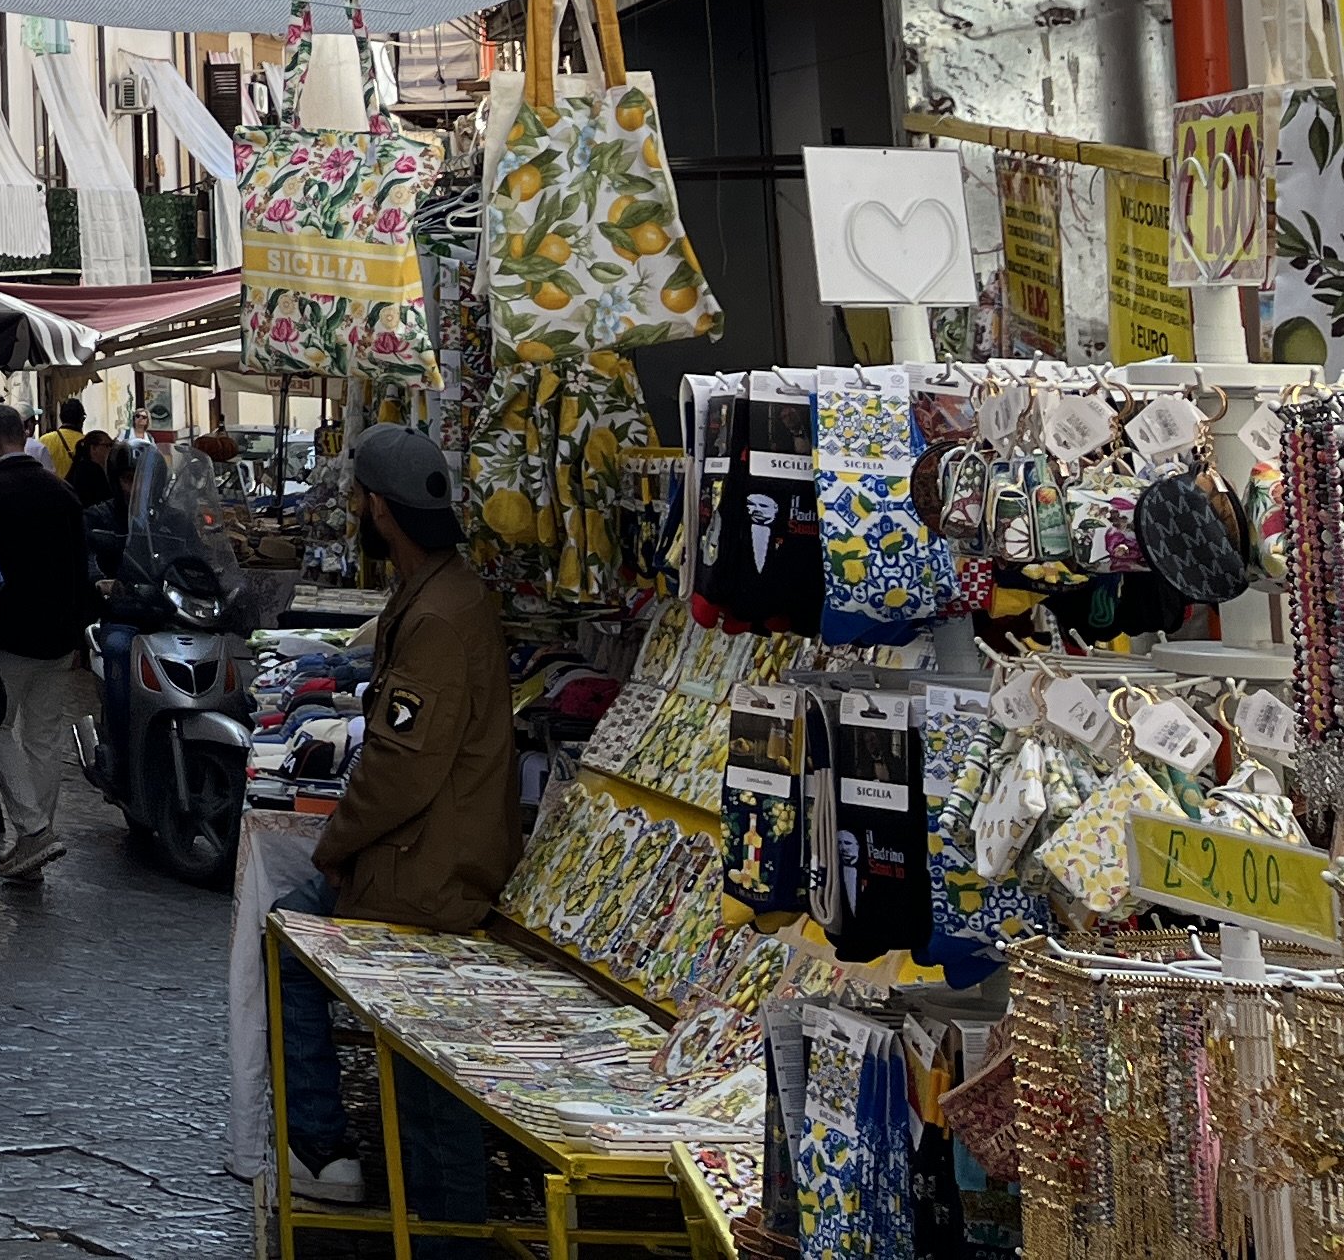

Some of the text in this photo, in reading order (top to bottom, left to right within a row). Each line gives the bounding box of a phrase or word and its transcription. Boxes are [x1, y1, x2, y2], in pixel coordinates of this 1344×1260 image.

[1119, 194, 1170, 230] WELCOME
[266, 249, 368, 283] SICILIA
[1137, 324, 1169, 356] EURO
[843, 460, 884, 470] SICILIA
[856, 786, 892, 800] SICILIA
[867, 843, 904, 864] Padrino
